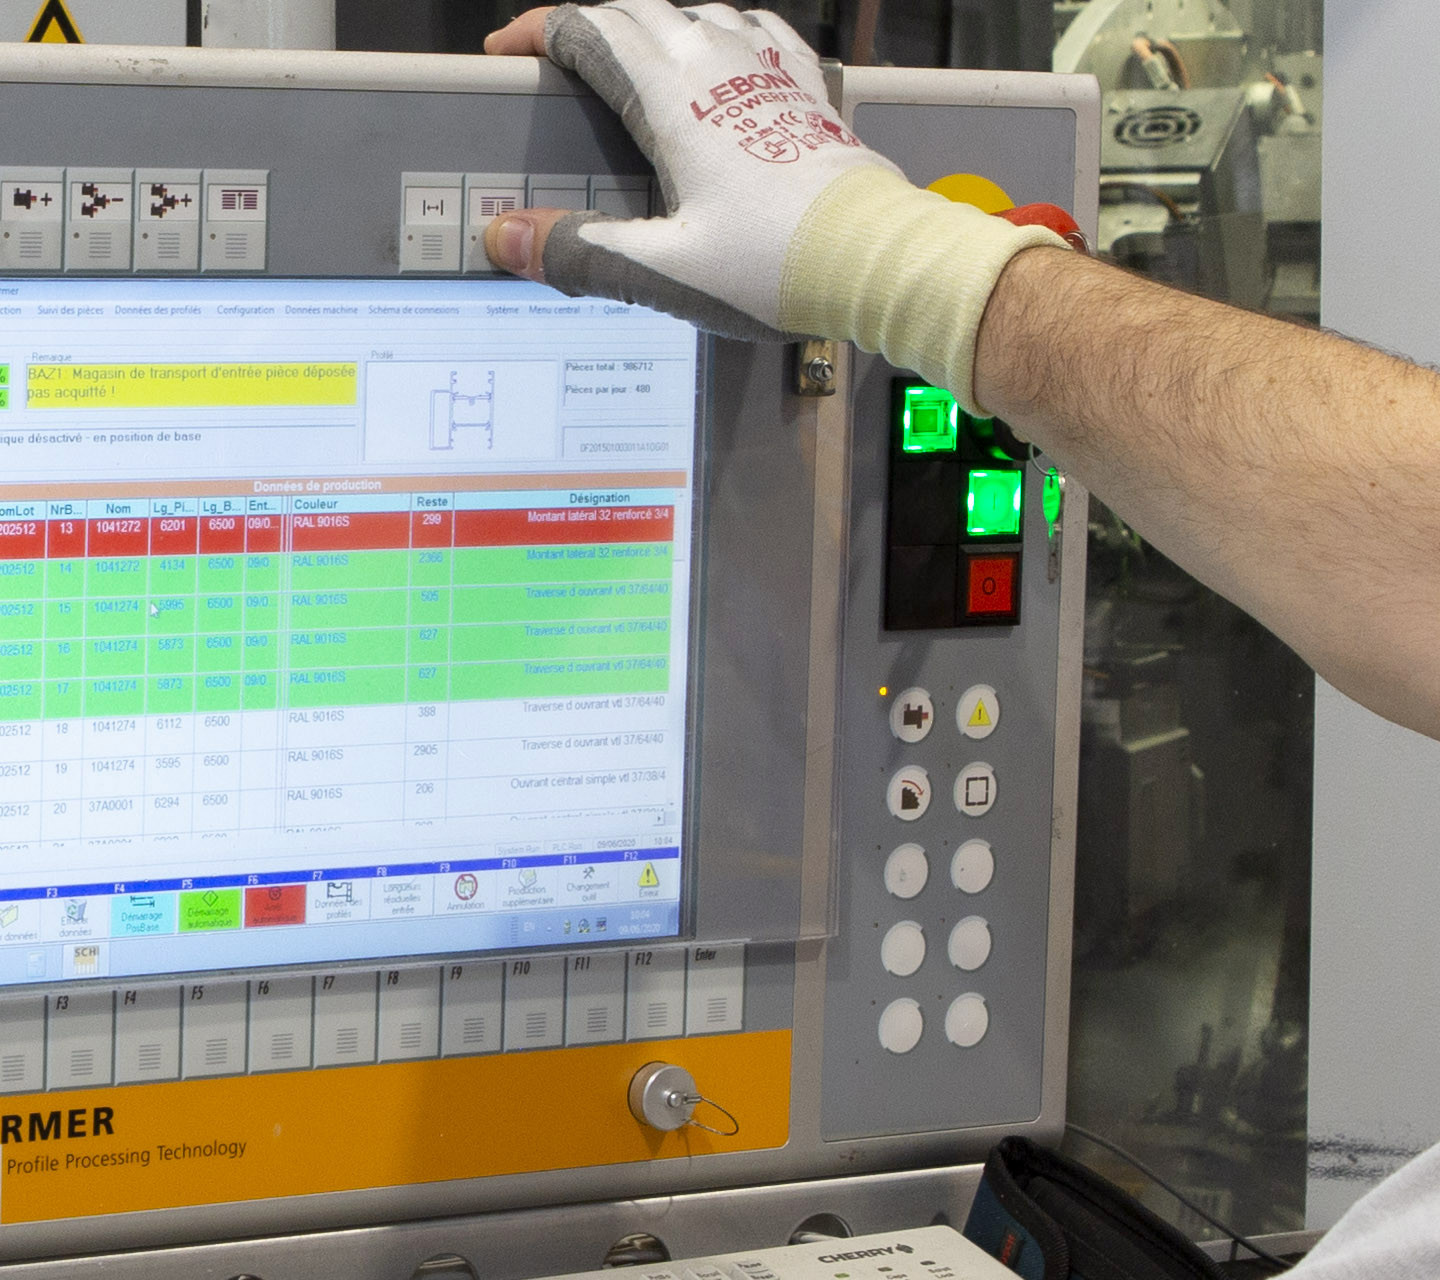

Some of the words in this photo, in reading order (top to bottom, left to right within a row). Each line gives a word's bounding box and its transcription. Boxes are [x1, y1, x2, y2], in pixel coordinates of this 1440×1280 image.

[690, 73, 792, 122] LEBON
[733, 118, 758, 133] 10
[37, 305, 58, 315] Suivi
[61, 305, 75, 315] des
[77, 305, 104, 317] pièces
[115, 305, 152, 315] Données
[154, 305, 168, 315] des
[171, 305, 202, 317] profilés
[217, 305, 275, 317] Configuration
[285, 305, 320, 314] Données
[323, 305, 359, 314] machine
[402, 305, 413, 314] de
[486, 305, 519, 317] Système
[529, 305, 552, 314] Menu
[554, 305, 581, 314] central
[603, 305, 631, 315] Quitter
[565, 362, 594, 371] Pièces
[596, 362, 616, 371] total
[73, 368, 125, 383] Magasin
[130, 368, 145, 379] de
[151, 367, 206, 382] transport
[211, 366, 262, 378] d'entrée
[266, 366, 299, 380] pièce
[303, 366, 356, 381] déposée
[27, 388, 50, 401] pas
[55, 385, 106, 401] acquitté
[565, 385, 593, 393] Pièces
[595, 387, 609, 395] par
[611, 386, 627, 395] jour
[635, 384, 651, 393] 480
[28, 433, 82, 444] désactivé
[93, 434, 107, 443] en
[110, 432, 154, 445] position
[157, 432, 171, 442] de
[174, 432, 202, 442] base
[253, 480, 304, 493] Données
[306, 480, 320, 492] de
[322, 479, 382, 493] production
[106, 503, 131, 514] Nom
[294, 499, 338, 511] Couleur
[416, 496, 448, 507] Reste
[570, 493, 630, 505] Désignation
[59, 522, 73, 534] 13
[96, 520, 141, 533] 1041272
[160, 519, 186, 532] 6201
[208, 518, 235, 531] 6500
[294, 516, 315, 528] RAL
[317, 515, 350, 527] 9016S
[422, 513, 442, 525] 299
[527, 510, 566, 522] Montant
[568, 509, 597, 521] latéral
[599, 509, 611, 521] 32
[613, 508, 652, 520] renforcé
[654, 507, 669, 519] 3/4
[53, 803, 67, 815] 20
[89, 799, 134, 813] 37A0001
[154, 796, 180, 809] 6294
[202, 794, 228, 807] 6500
[287, 789, 308, 801] RAL
[310, 787, 343, 799] 9016S
[415, 782, 434, 795] 206
[510, 778, 549, 789] Ouvrant
[551, 775, 583, 787] central
[585, 773, 617, 786] simple
[56, 995, 69, 1010] F3
[124, 990, 137, 1005] F4
[191, 985, 204, 1000] F5
[257, 980, 270, 995] F6
[323, 975, 335, 990] F7
[387, 970, 399, 986] F8
[450, 965, 462, 980] F9
[513, 961, 530, 976] F10
[574, 956, 591, 971] F11
[634, 951, 653, 967] F12
[695, 947, 717, 963] Enter
[7, 1155, 59, 1175] Profile
[66, 1148, 151, 1169] Processing
[158, 1139, 248, 1161] Technology
[817, 1247, 895, 1264] CHERRY
